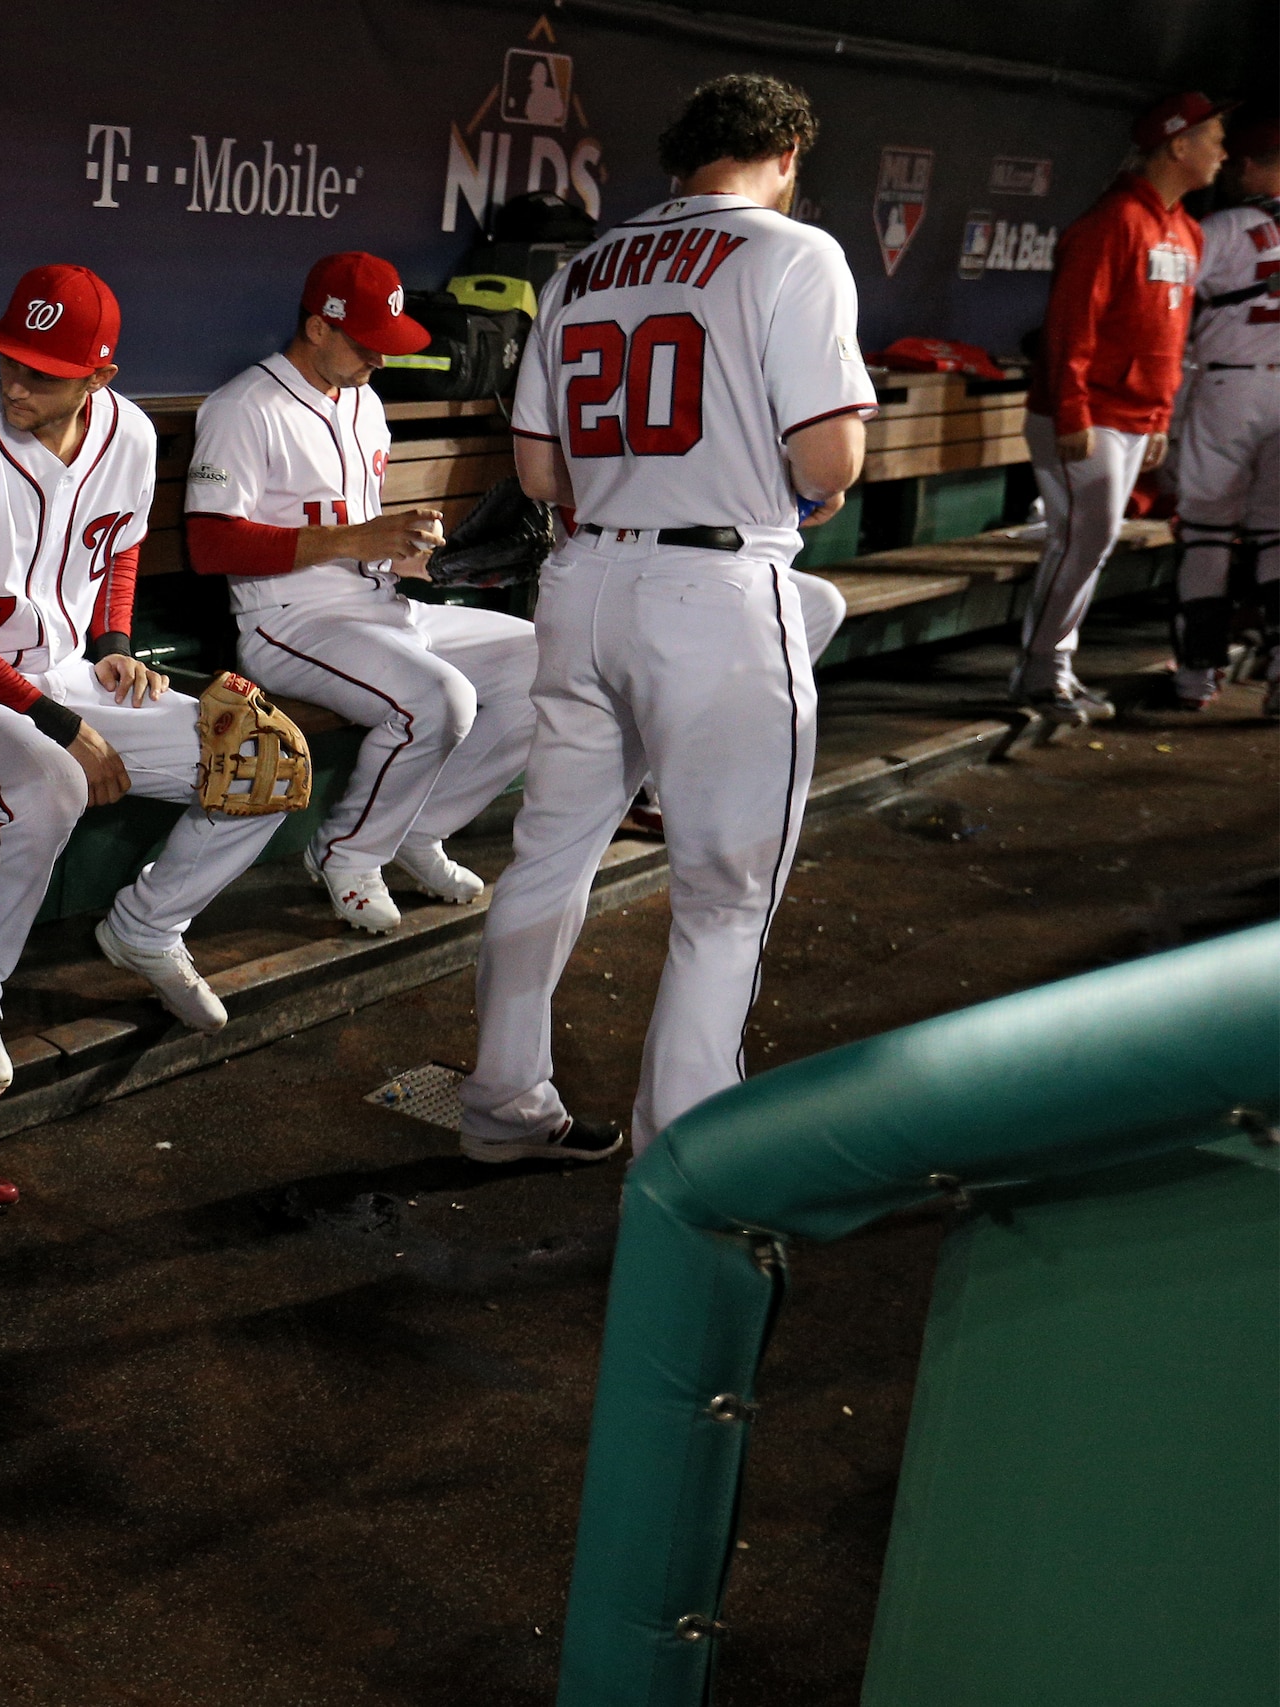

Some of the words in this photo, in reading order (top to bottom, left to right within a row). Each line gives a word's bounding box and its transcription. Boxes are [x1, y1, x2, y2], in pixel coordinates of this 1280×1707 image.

[563, 228, 748, 307] MURPHY
[25, 299, 64, 331] W
[562, 312, 706, 458] 20
